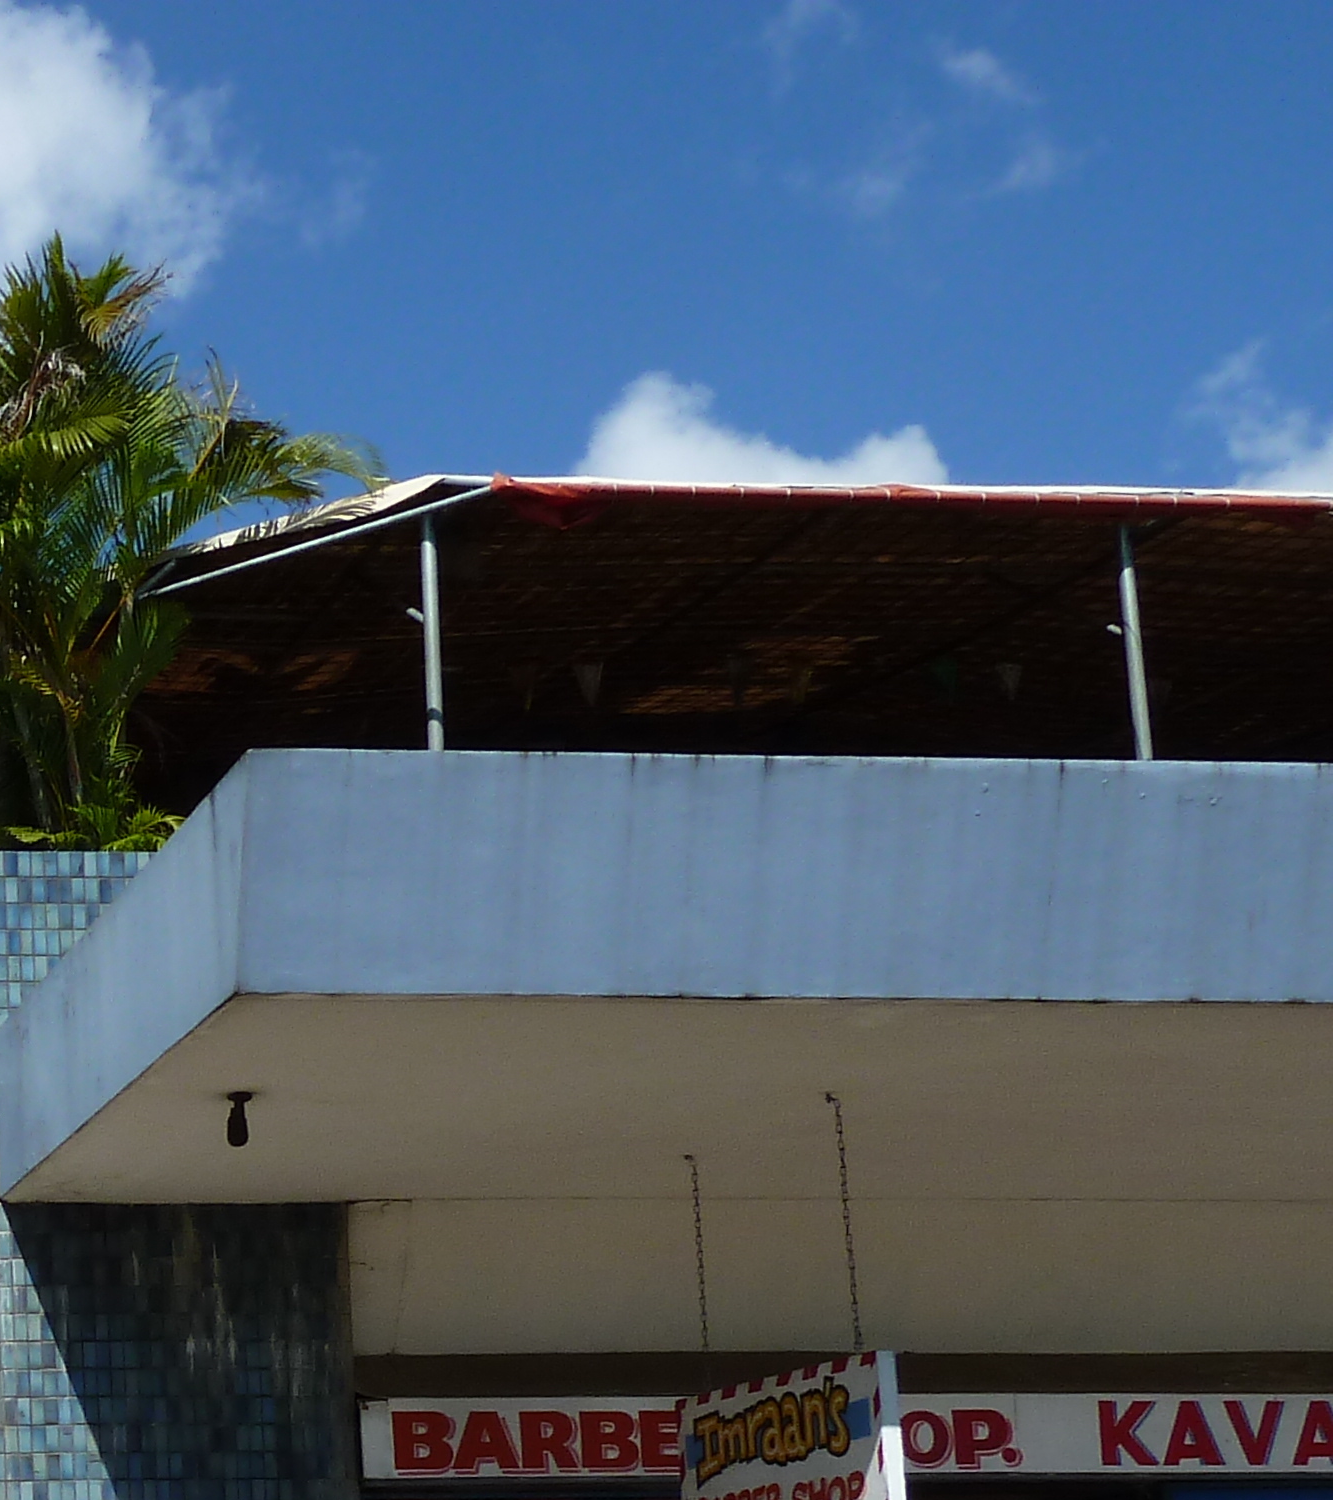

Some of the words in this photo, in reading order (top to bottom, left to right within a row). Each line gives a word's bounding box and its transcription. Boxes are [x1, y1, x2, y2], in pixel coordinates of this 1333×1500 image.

[393, 1410, 680, 1474] BARBE
[1098, 1400, 1333, 1466] KAVA
[694, 1376, 850, 1490] Imraan's
